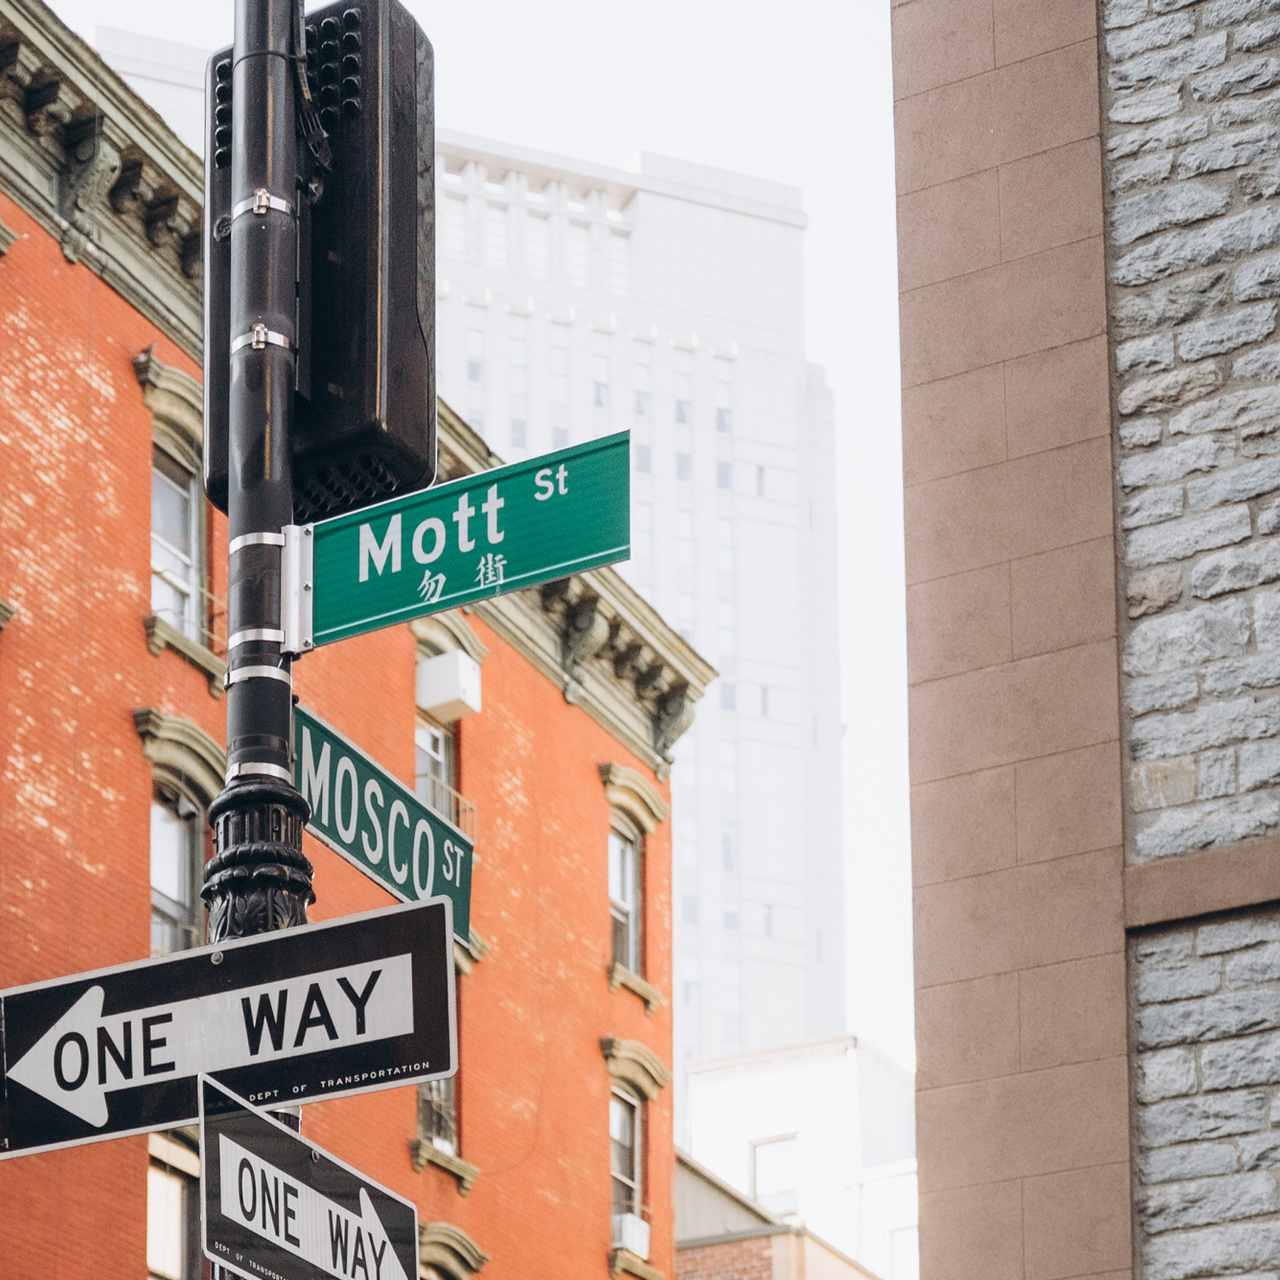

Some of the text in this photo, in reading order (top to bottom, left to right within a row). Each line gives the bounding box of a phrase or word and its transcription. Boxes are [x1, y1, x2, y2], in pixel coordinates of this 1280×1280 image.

[358, 463, 569, 583] Mott St
[301, 725, 465, 900] MOSCO ST
[53, 969, 384, 1092] ONE WAY
[249, 1061, 430, 1102] DEPT OF TRANSPORTATION
[214, 1240, 230, 1255] DEPT
[235, 1252, 244, 1262] OF
[238, 1157, 300, 1249] ONE
